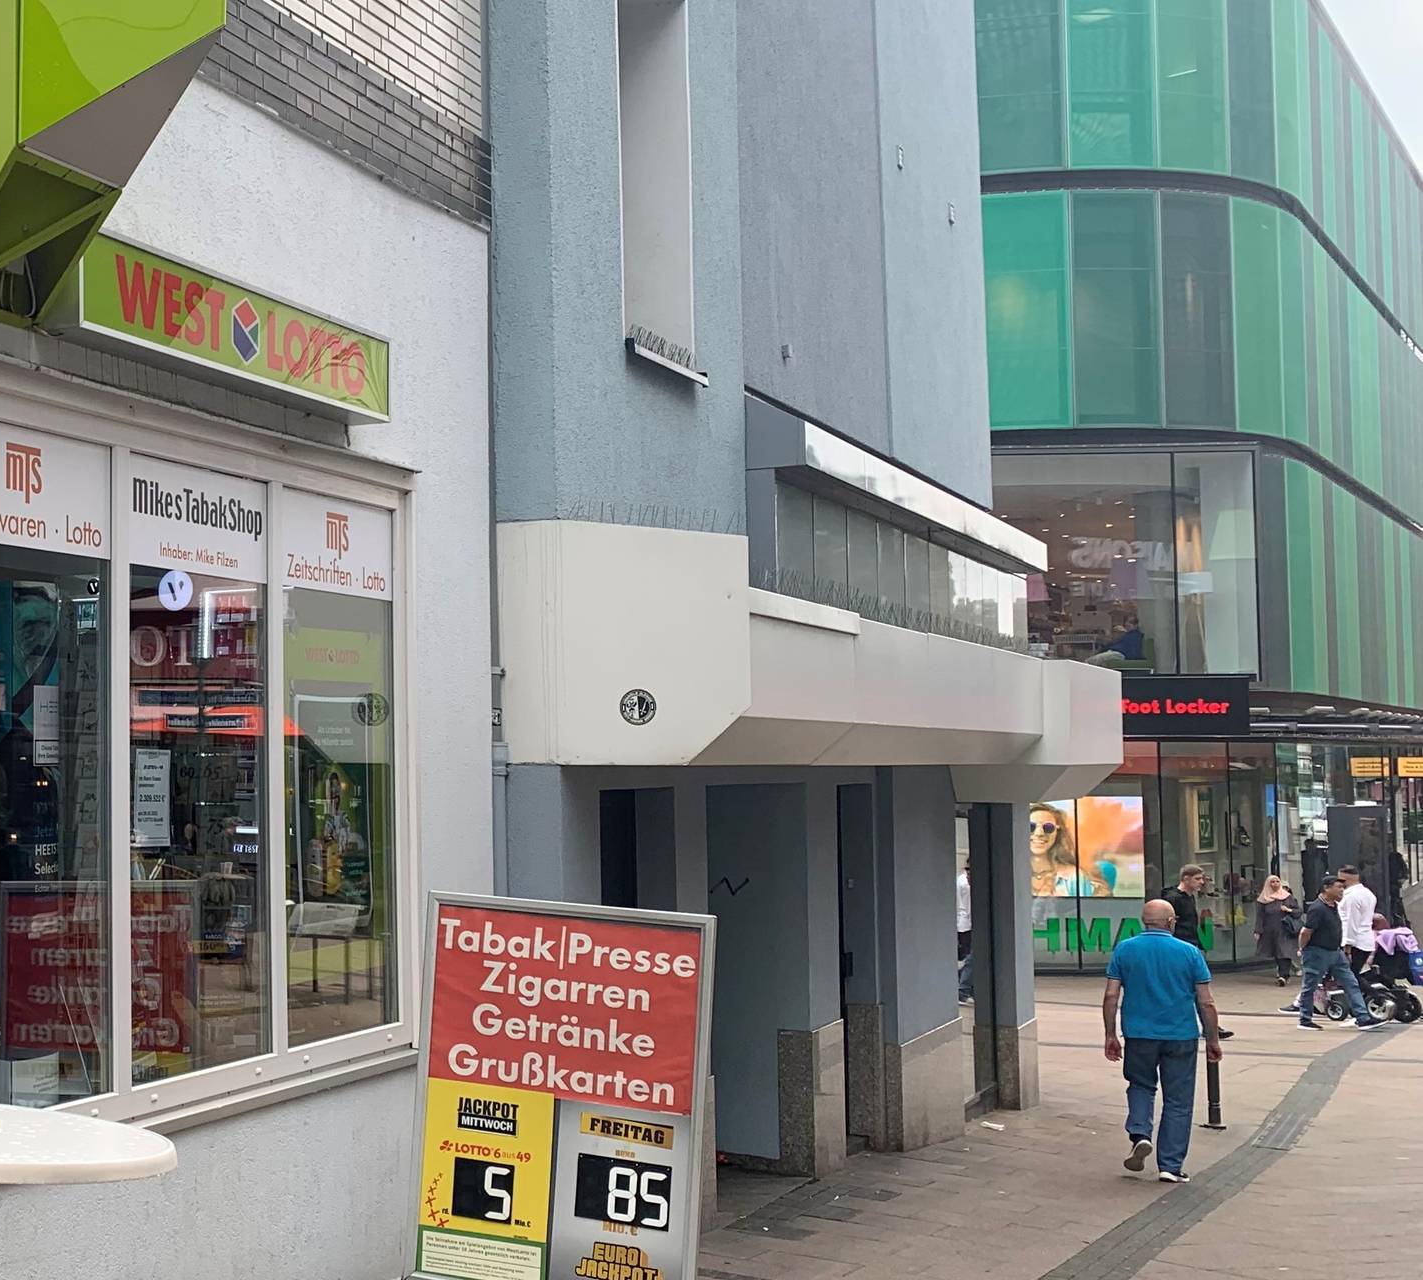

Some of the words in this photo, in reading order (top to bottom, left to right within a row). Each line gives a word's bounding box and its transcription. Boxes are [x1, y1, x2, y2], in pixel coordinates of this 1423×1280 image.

[115, 254, 226, 352] WEST
[266, 310, 365, 396] LOTTO
[66, 514, 102, 548] Lotto
[159, 541, 194, 562] Inhaber:
[195, 548, 215, 565] Mike
[216, 551, 239, 568] Filzen
[287, 553, 352, 587] Zeitschriften
[362, 566, 386, 592] Lotto
[1121, 698, 1161, 714] Foot
[1165, 697, 1230, 714] Locker
[34, 844, 58, 856] HEETS
[479, 960, 651, 1012] Zigarren
[472, 1003, 655, 1057] Getränke
[447, 1043, 675, 1106] Grußkarten
[457, 1096, 519, 1119] JACKPOT
[461, 1115, 514, 1132] MITTWOCH
[589, 1117, 665, 1145] FREITAG
[483, 1165, 511, 1221] 5
[607, 1166, 669, 1228] 85
[576, 1257, 659, 1280] JACKPOT
[593, 1242, 642, 1266] EURO
